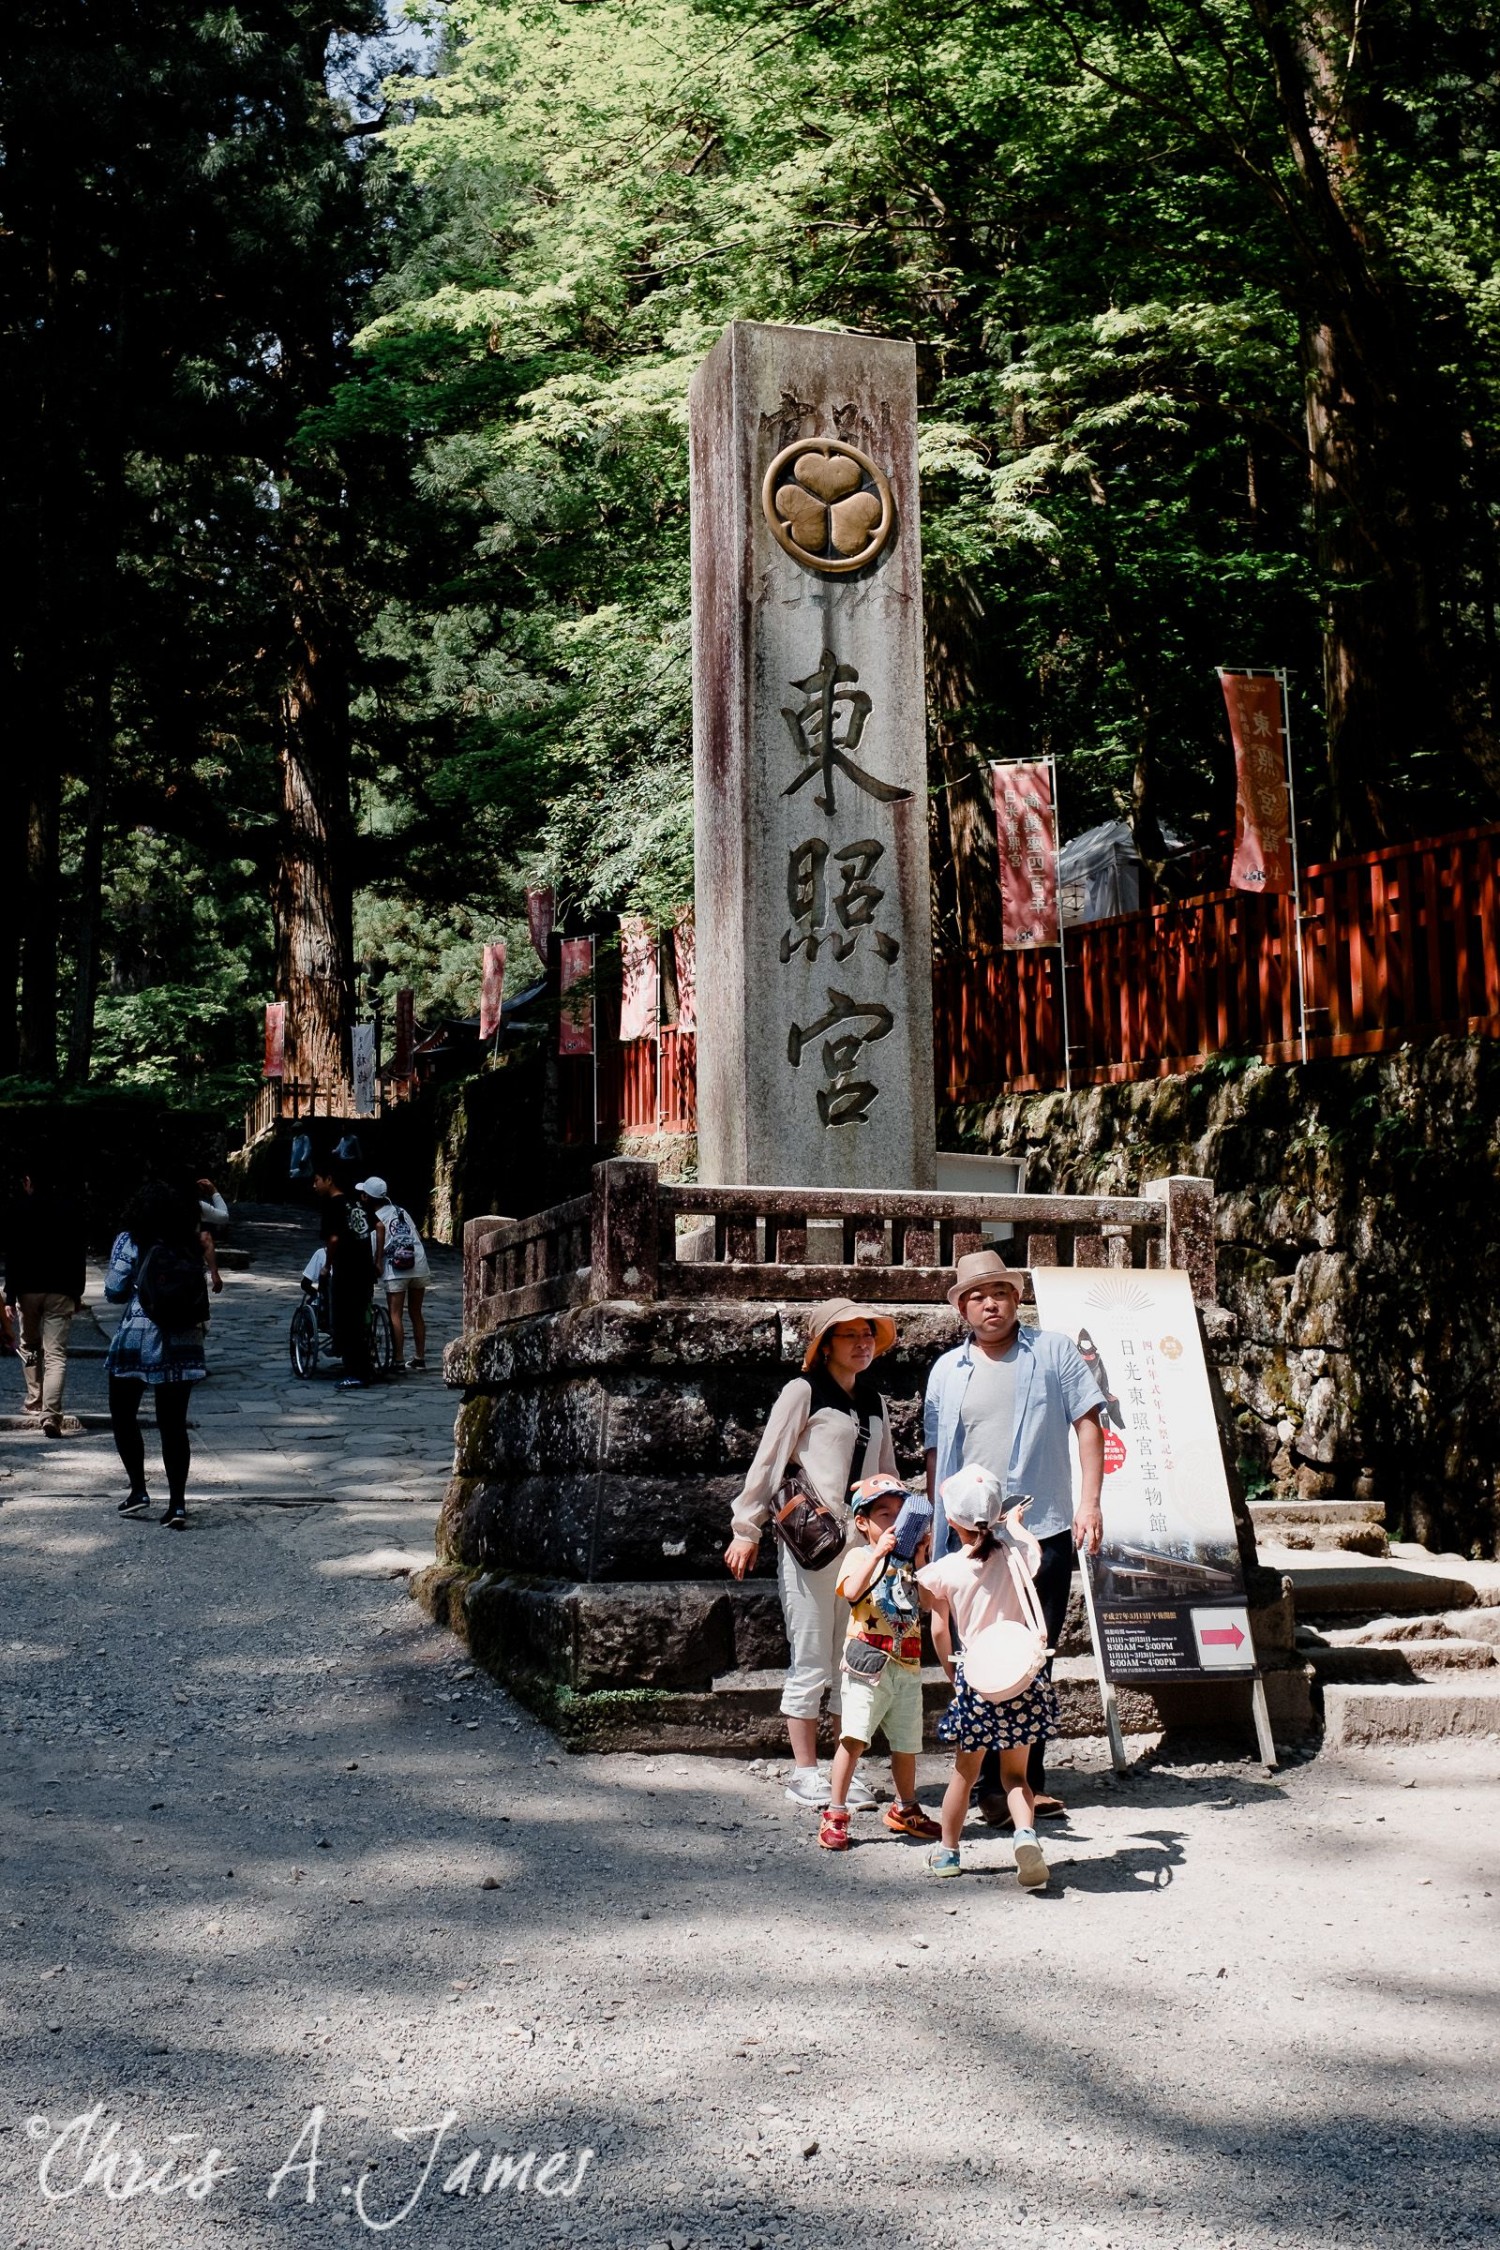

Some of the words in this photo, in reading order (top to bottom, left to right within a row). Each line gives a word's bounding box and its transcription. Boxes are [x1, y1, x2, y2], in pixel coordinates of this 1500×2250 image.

[779, 648, 916, 1129] 東照宮
[1120, 1339, 1168, 1533] 日光東照宮宝物館
